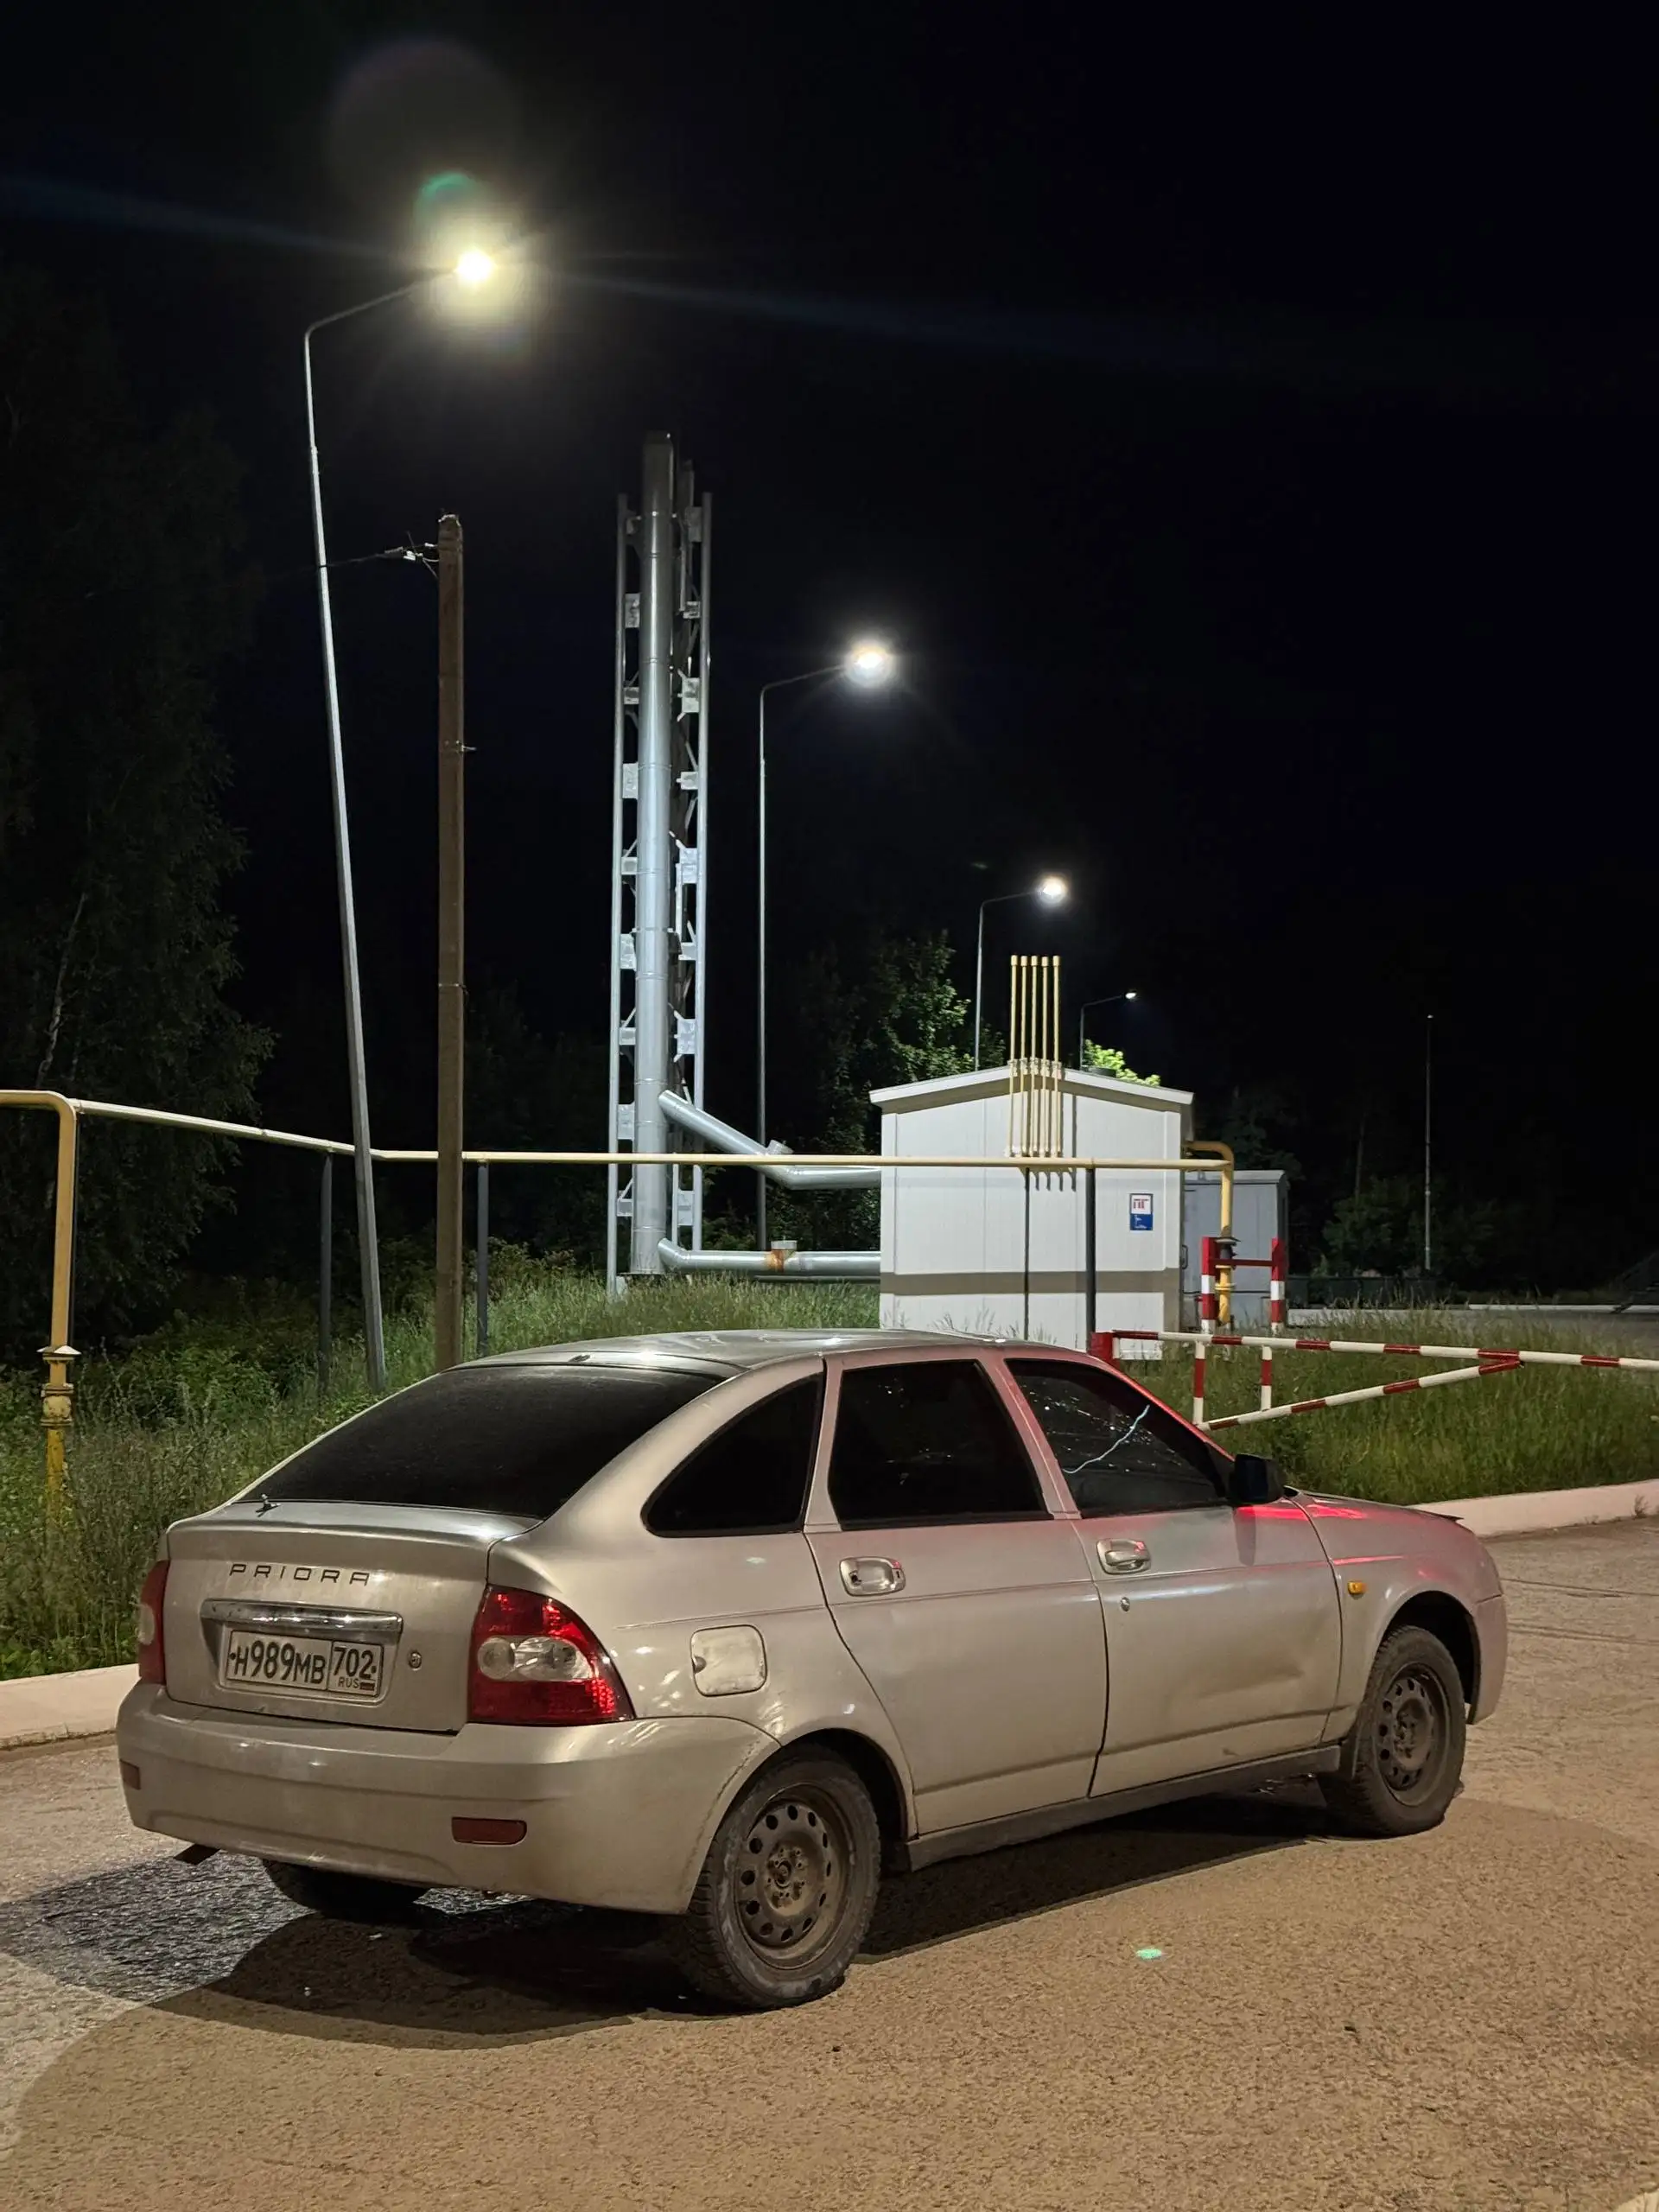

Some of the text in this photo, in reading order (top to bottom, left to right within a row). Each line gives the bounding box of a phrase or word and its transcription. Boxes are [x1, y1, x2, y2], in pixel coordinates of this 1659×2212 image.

[229, 1563, 371, 1586] PRIORA
[334, 1646, 374, 1680] 702
[338, 1676, 359, 1689] RUS
